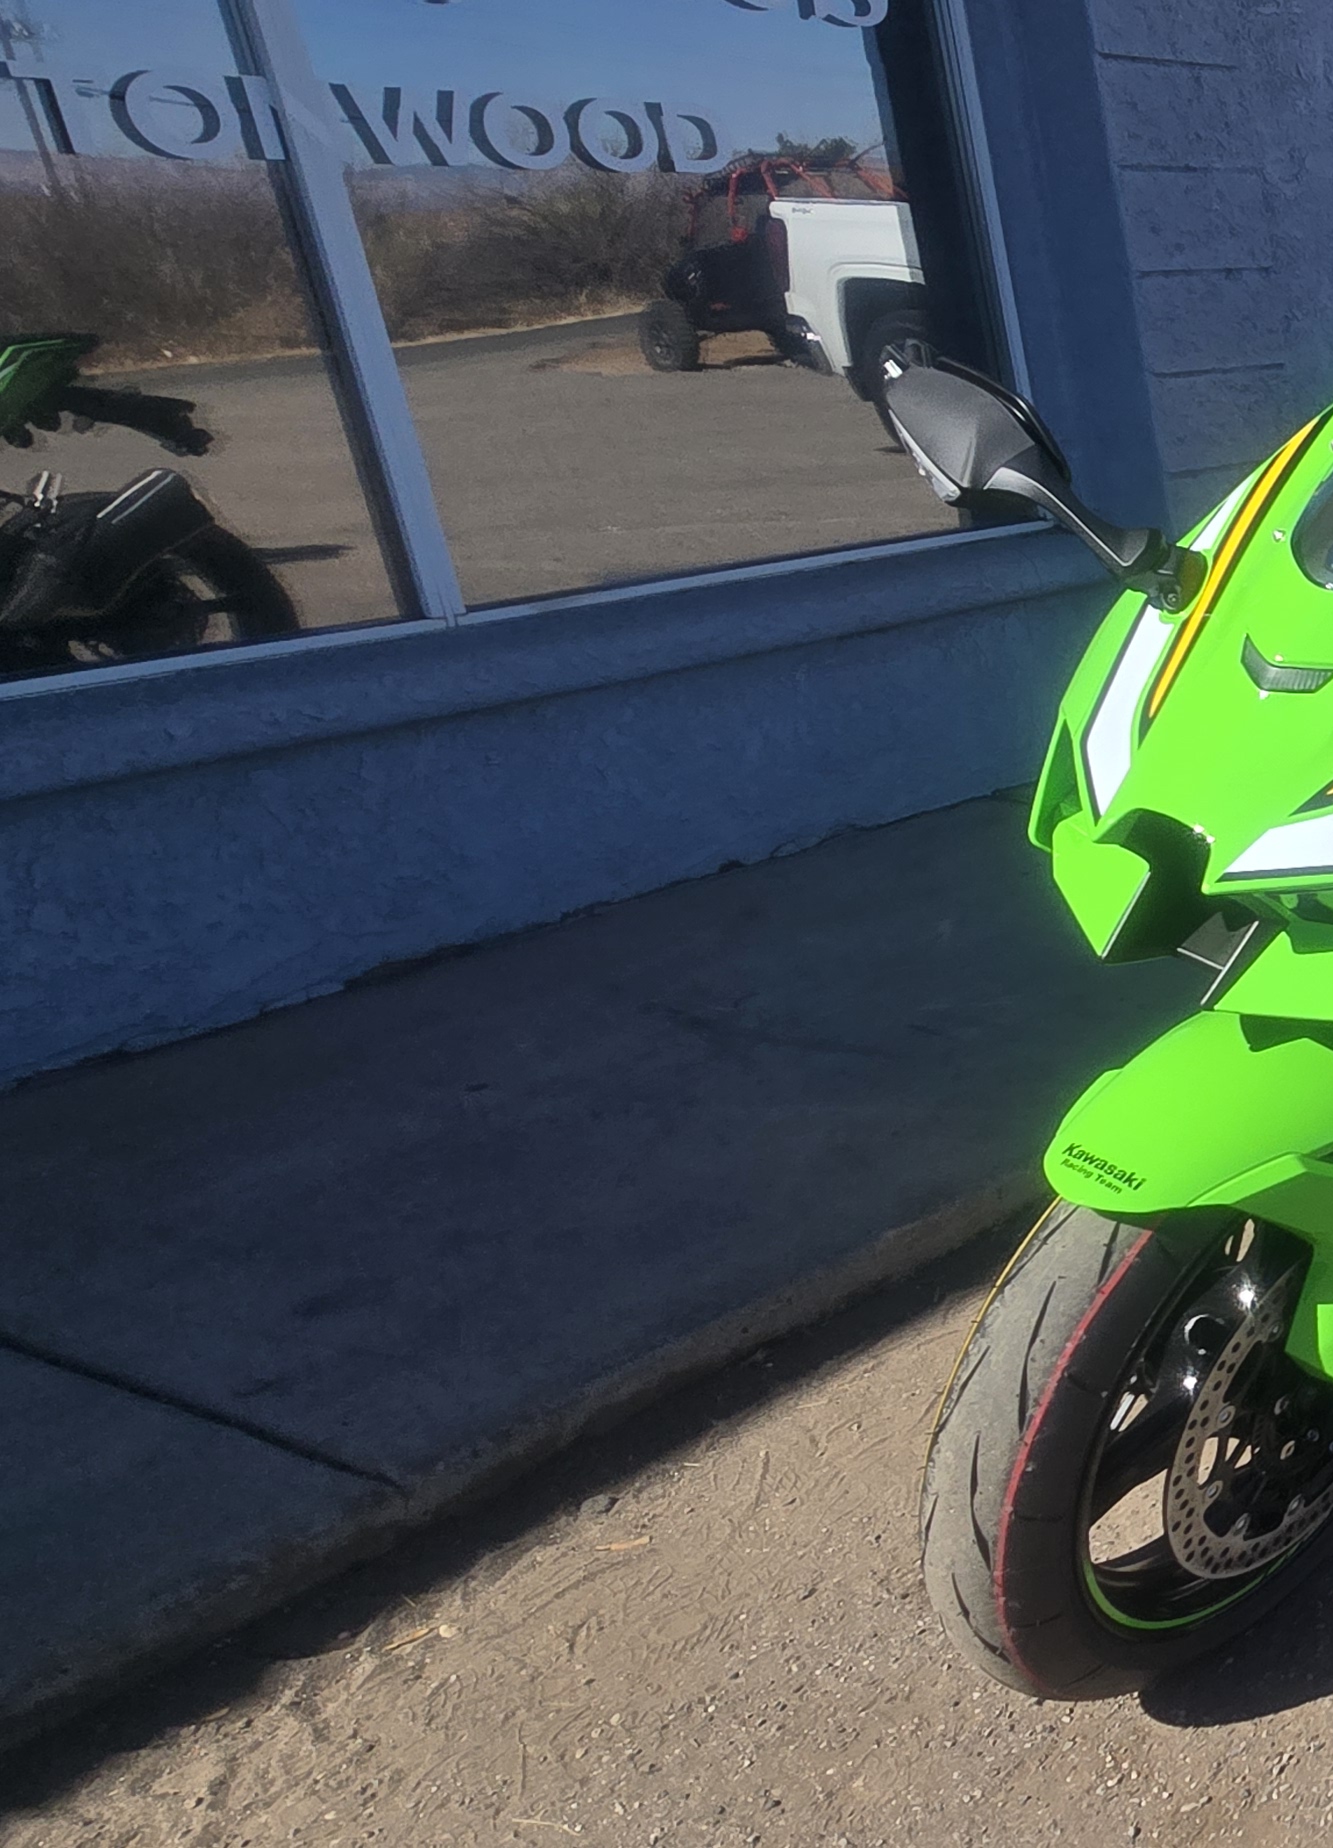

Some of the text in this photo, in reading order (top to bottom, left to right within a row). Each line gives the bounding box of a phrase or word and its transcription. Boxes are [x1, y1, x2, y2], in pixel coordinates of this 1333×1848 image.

[1060, 1158, 1123, 1194] Racing Team
[1061, 1142, 1148, 1191] Kawasaki
